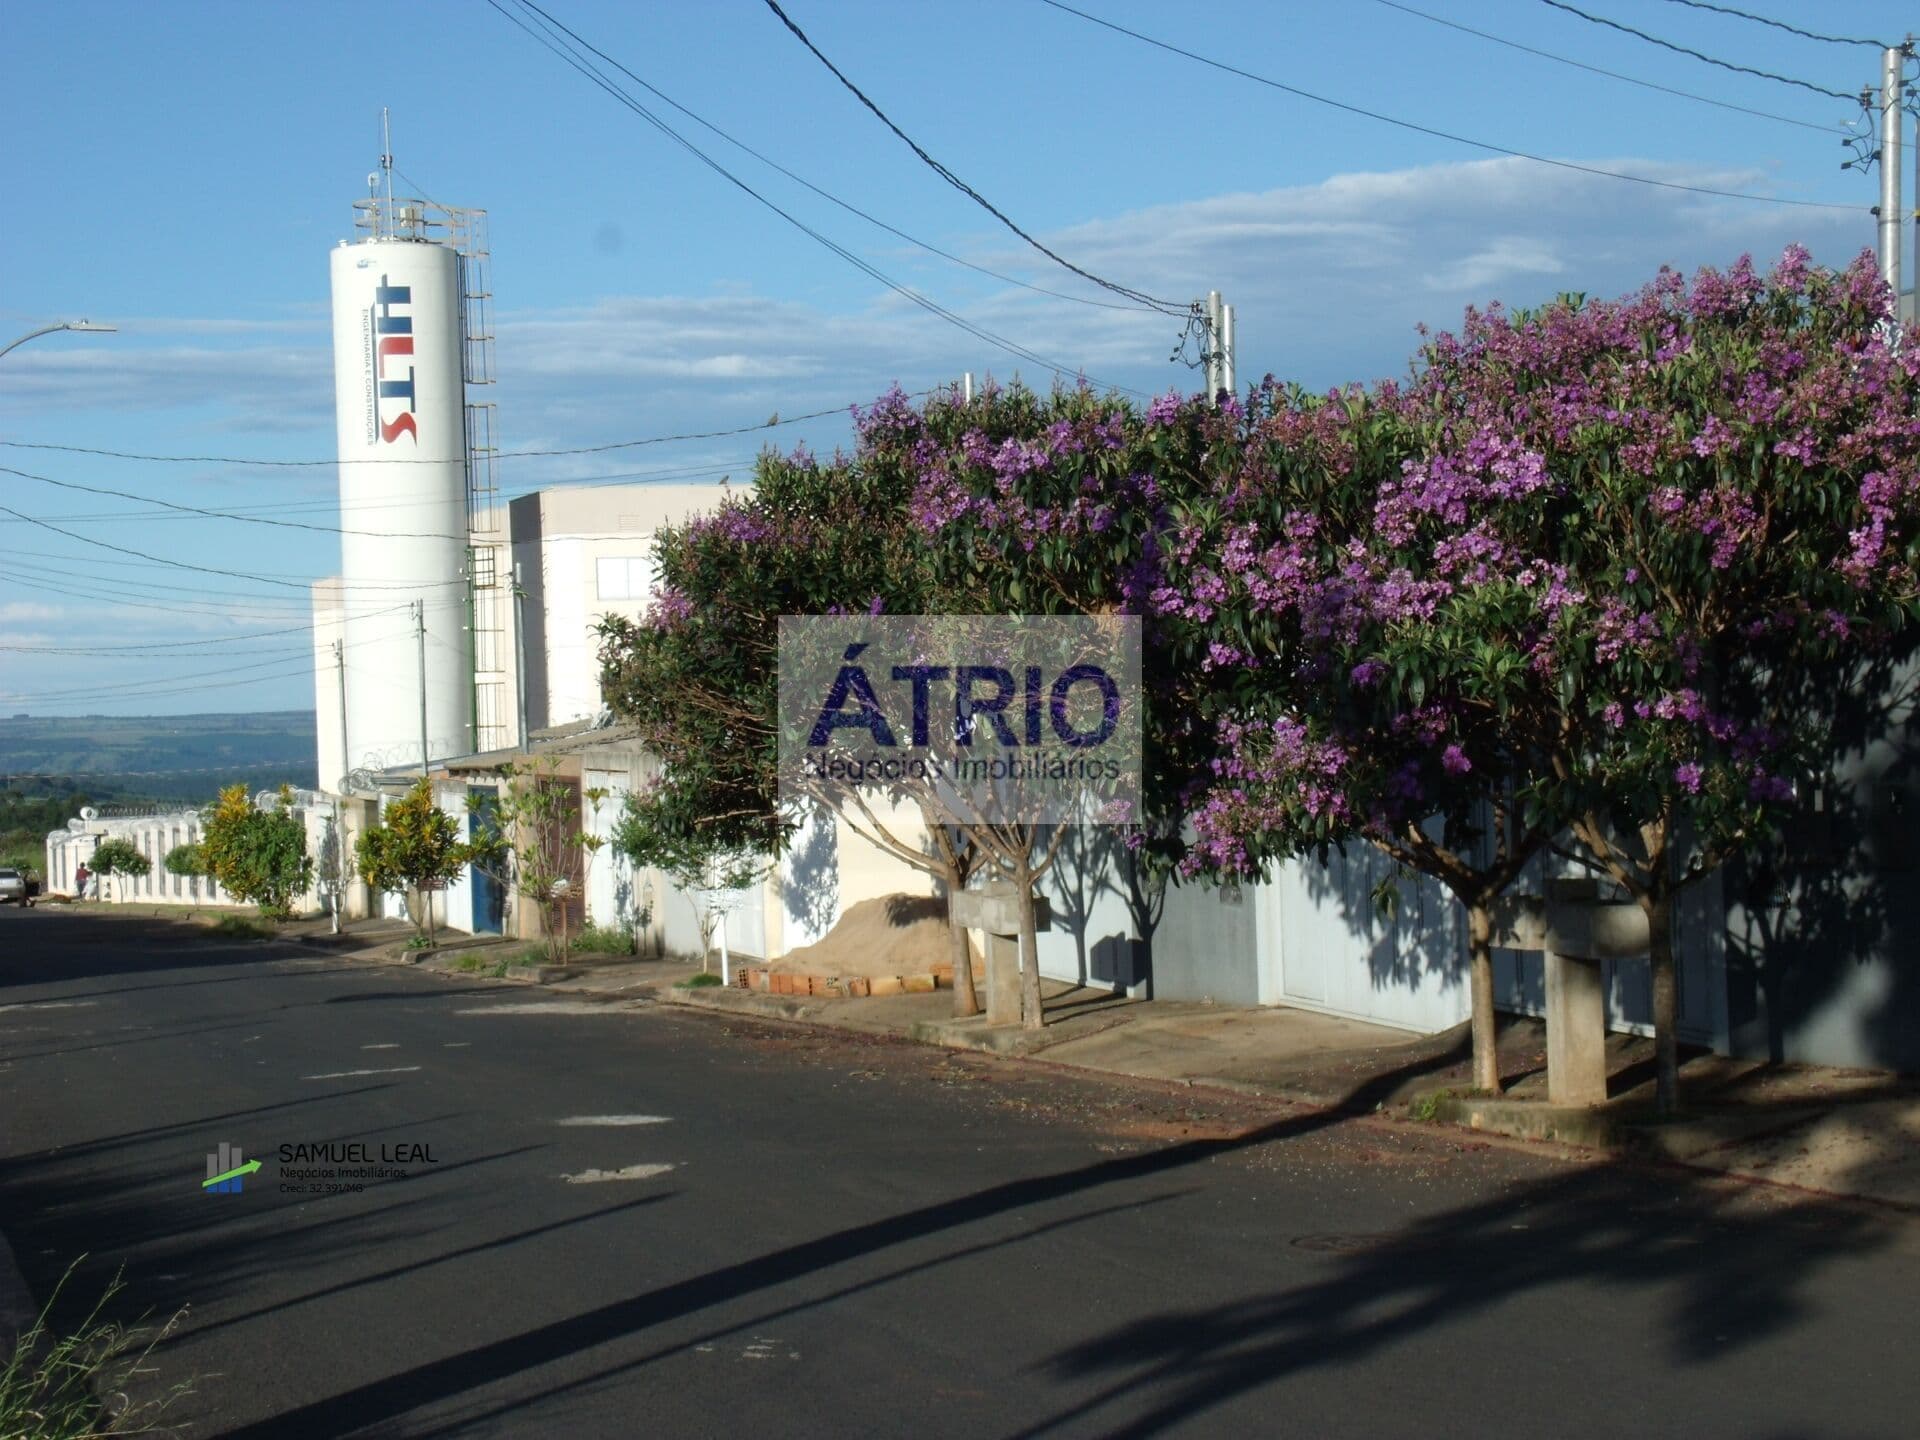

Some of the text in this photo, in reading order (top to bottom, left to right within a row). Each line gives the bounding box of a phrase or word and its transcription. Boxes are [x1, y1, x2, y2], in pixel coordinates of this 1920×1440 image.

[362, 309, 371, 368] ENGENHARIA
[376, 274, 418, 447] HLTS
[365, 378, 374, 446] CONSTRUÇÕES
